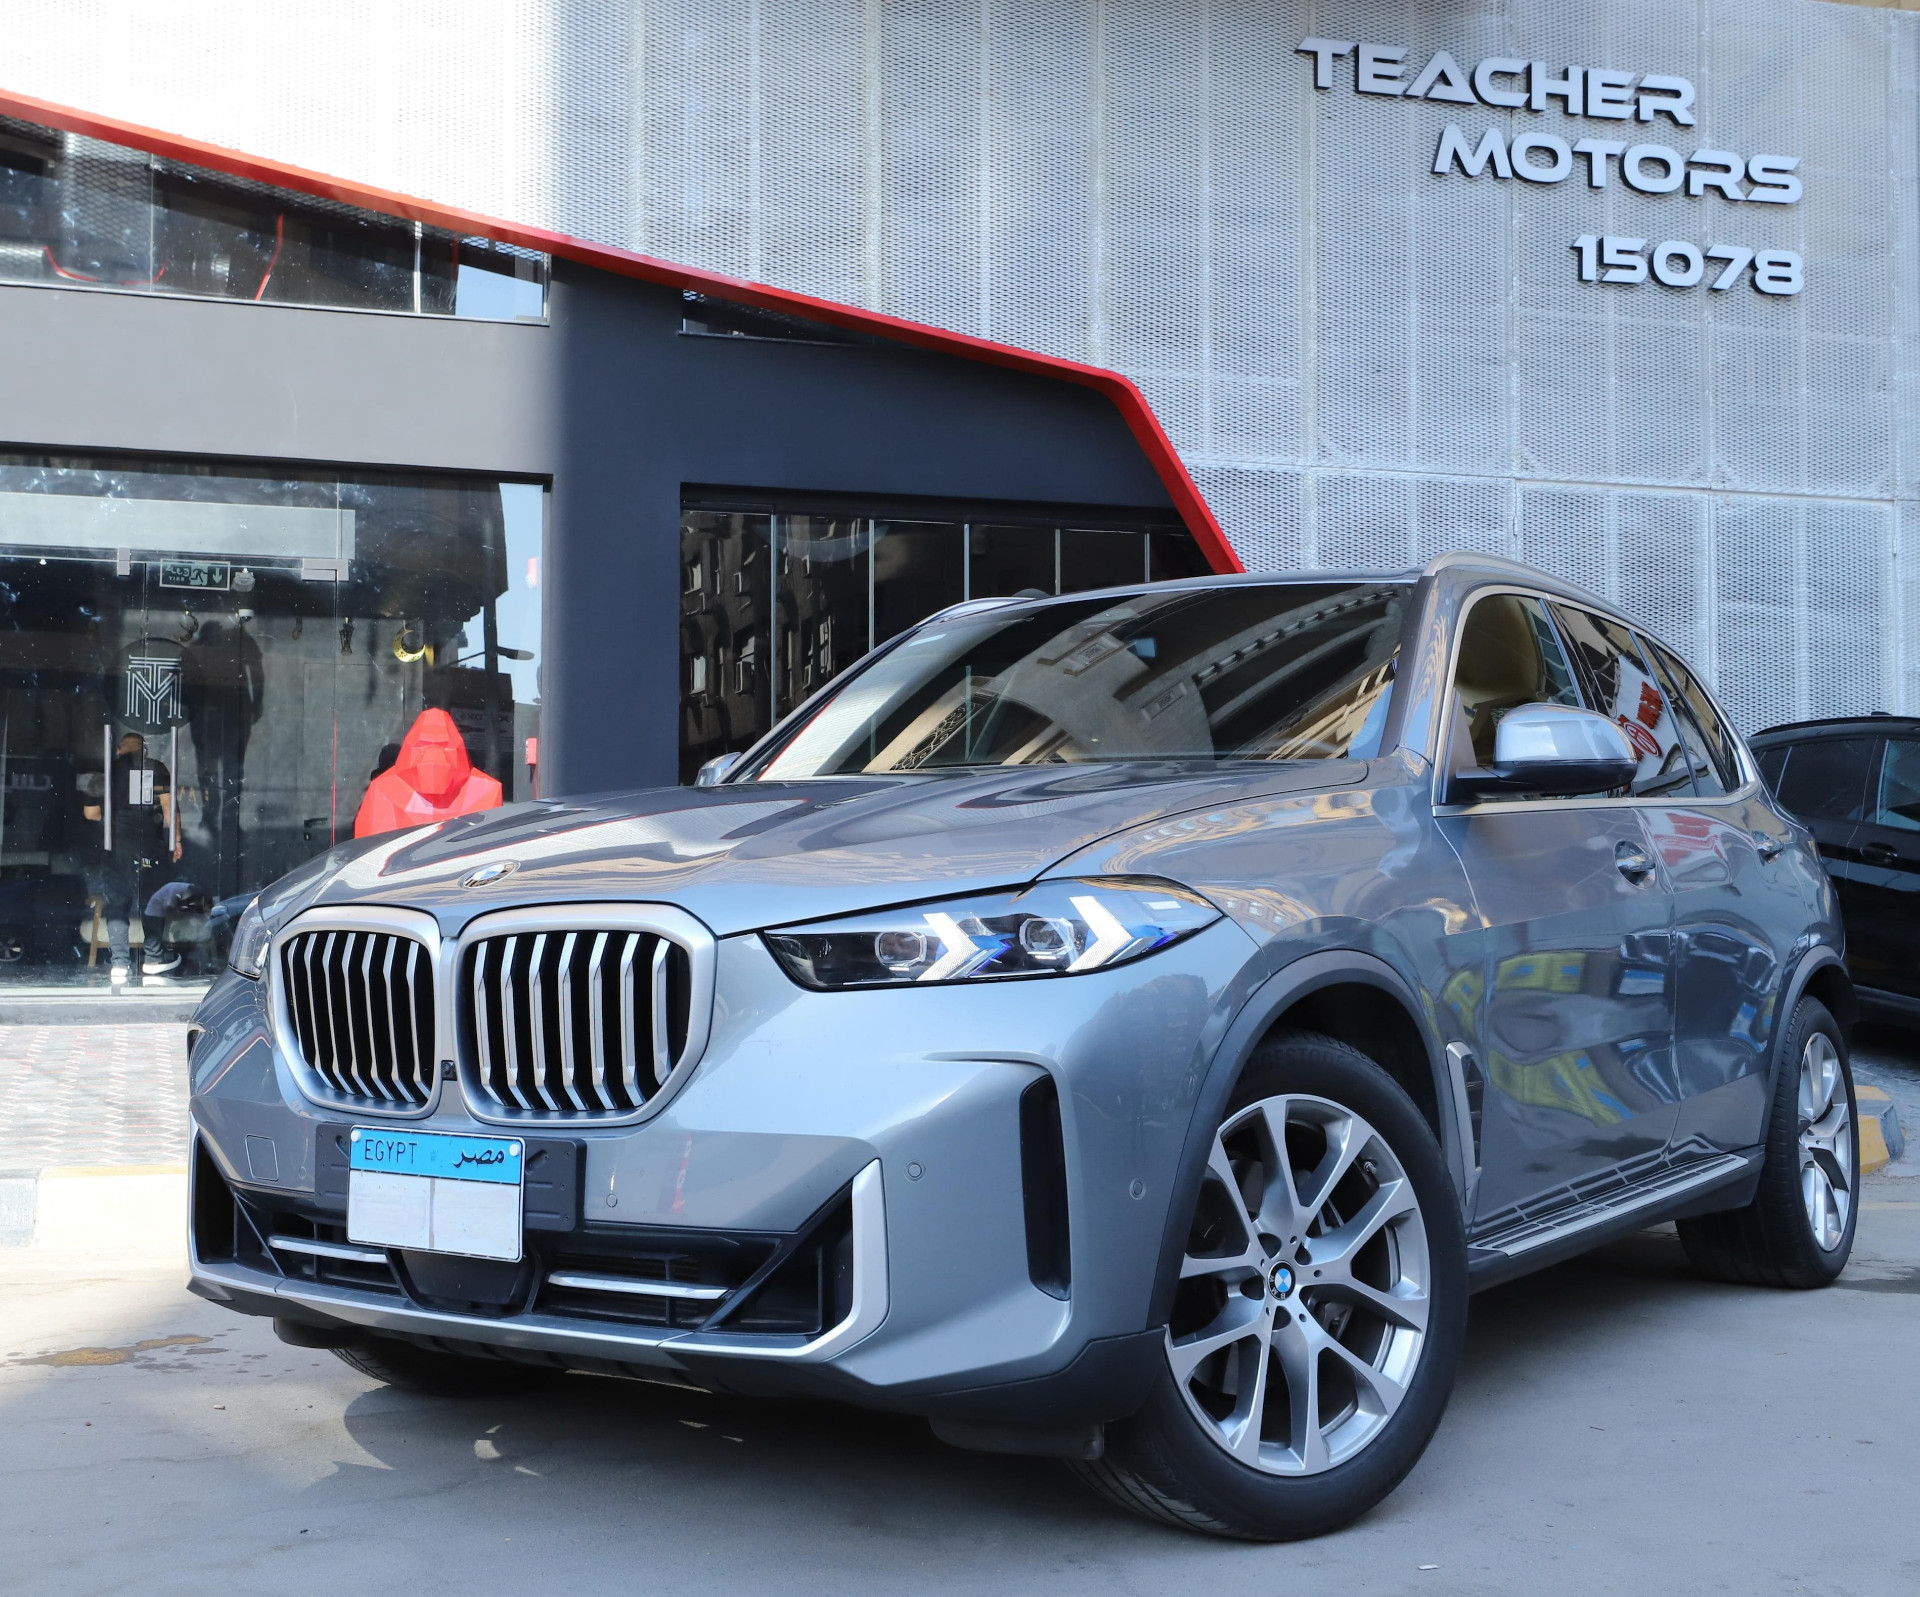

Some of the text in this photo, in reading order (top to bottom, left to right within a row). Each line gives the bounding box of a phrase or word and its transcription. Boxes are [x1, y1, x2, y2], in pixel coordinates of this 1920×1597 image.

[1294, 37, 1697, 126] TEACHER
[1431, 123, 1803, 204] MOTORS
[1572, 233, 1804, 296] 15078
[364, 1138, 418, 1165] EGYPT
[451, 1148, 506, 1169] مصر
